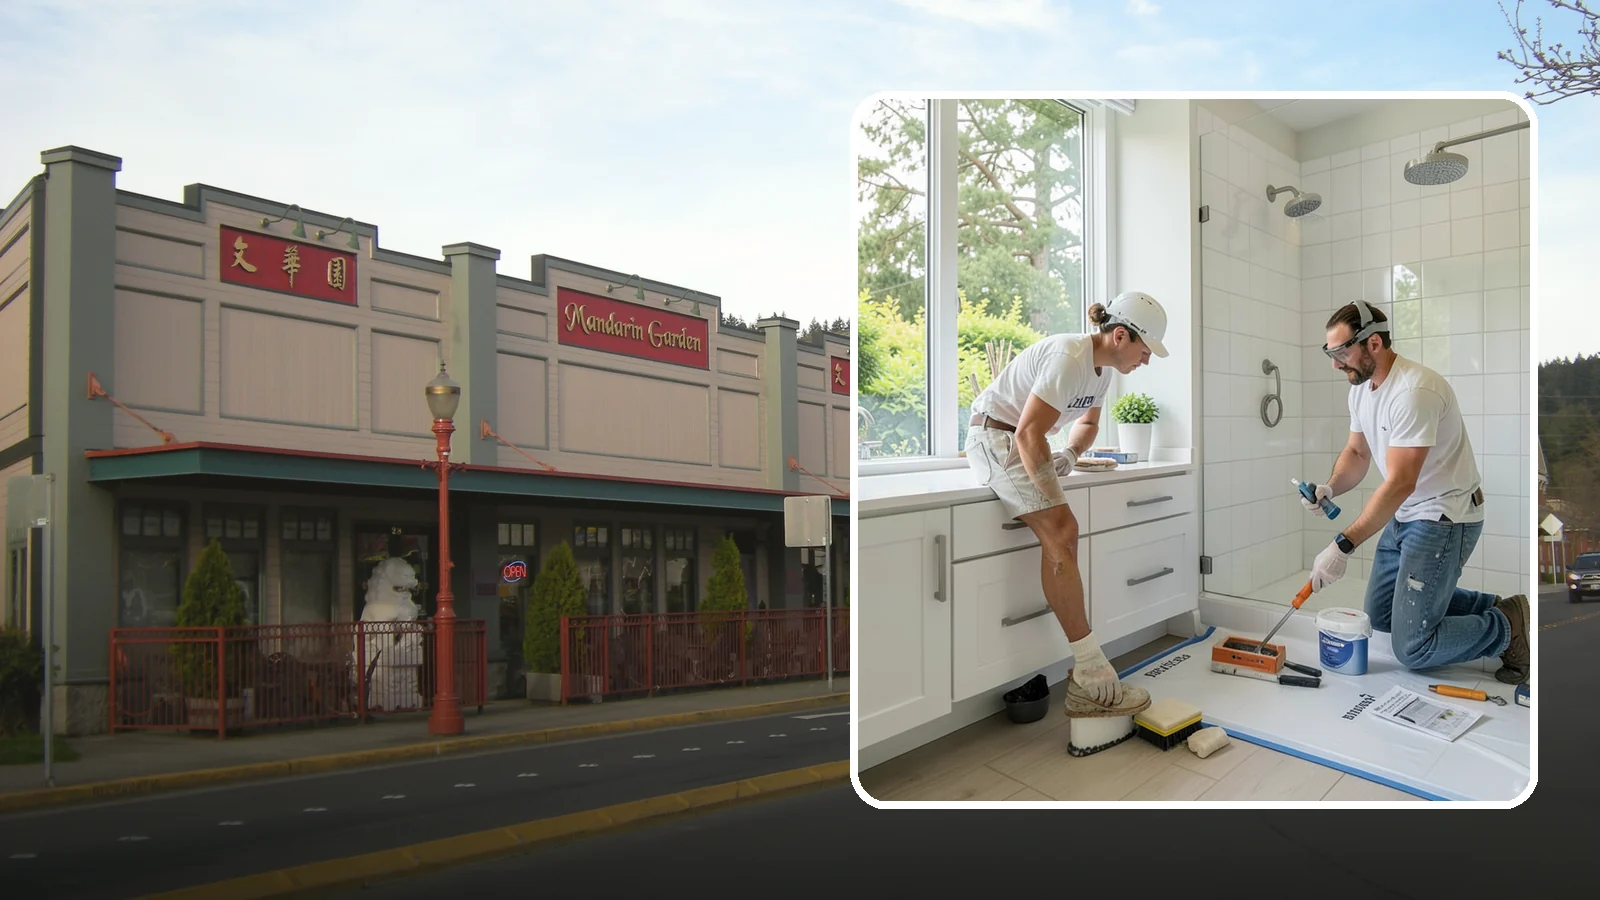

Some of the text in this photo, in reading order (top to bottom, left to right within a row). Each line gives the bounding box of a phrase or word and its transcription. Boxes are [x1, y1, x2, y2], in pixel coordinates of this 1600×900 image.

[231, 236, 346, 290] 文華園
[565, 302, 702, 352] Mandarin Garden
[503, 565, 527, 578] OPEN
